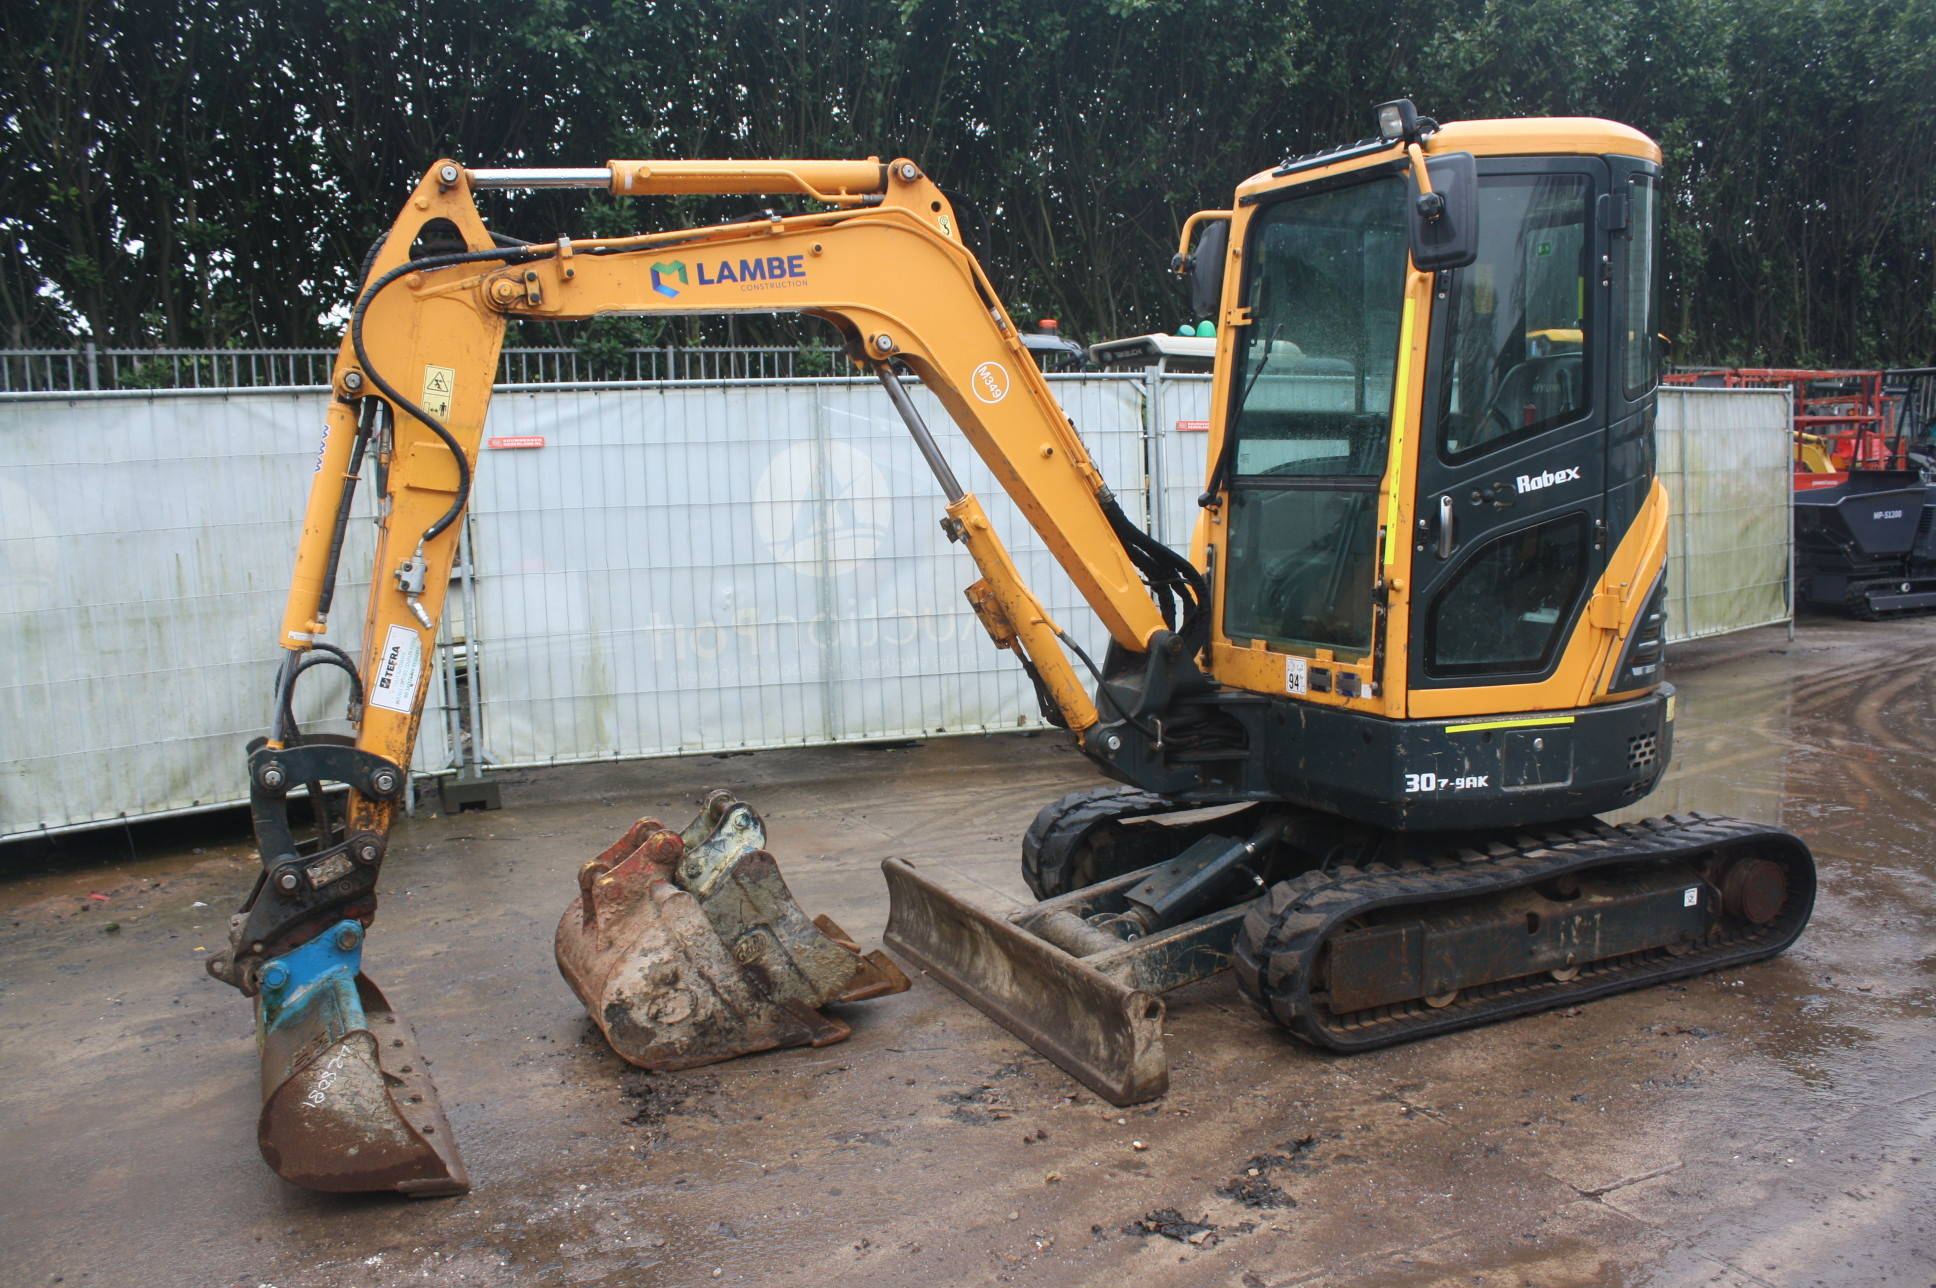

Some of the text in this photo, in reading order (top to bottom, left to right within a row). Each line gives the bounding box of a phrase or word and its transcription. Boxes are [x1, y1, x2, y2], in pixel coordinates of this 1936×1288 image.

[696, 254, 806, 286] LAMBE
[740, 279, 808, 292] CONSTRUCTION
[977, 366, 1002, 399] M349
[1516, 466, 1580, 494] Robex
[1288, 673, 1300, 691] 94
